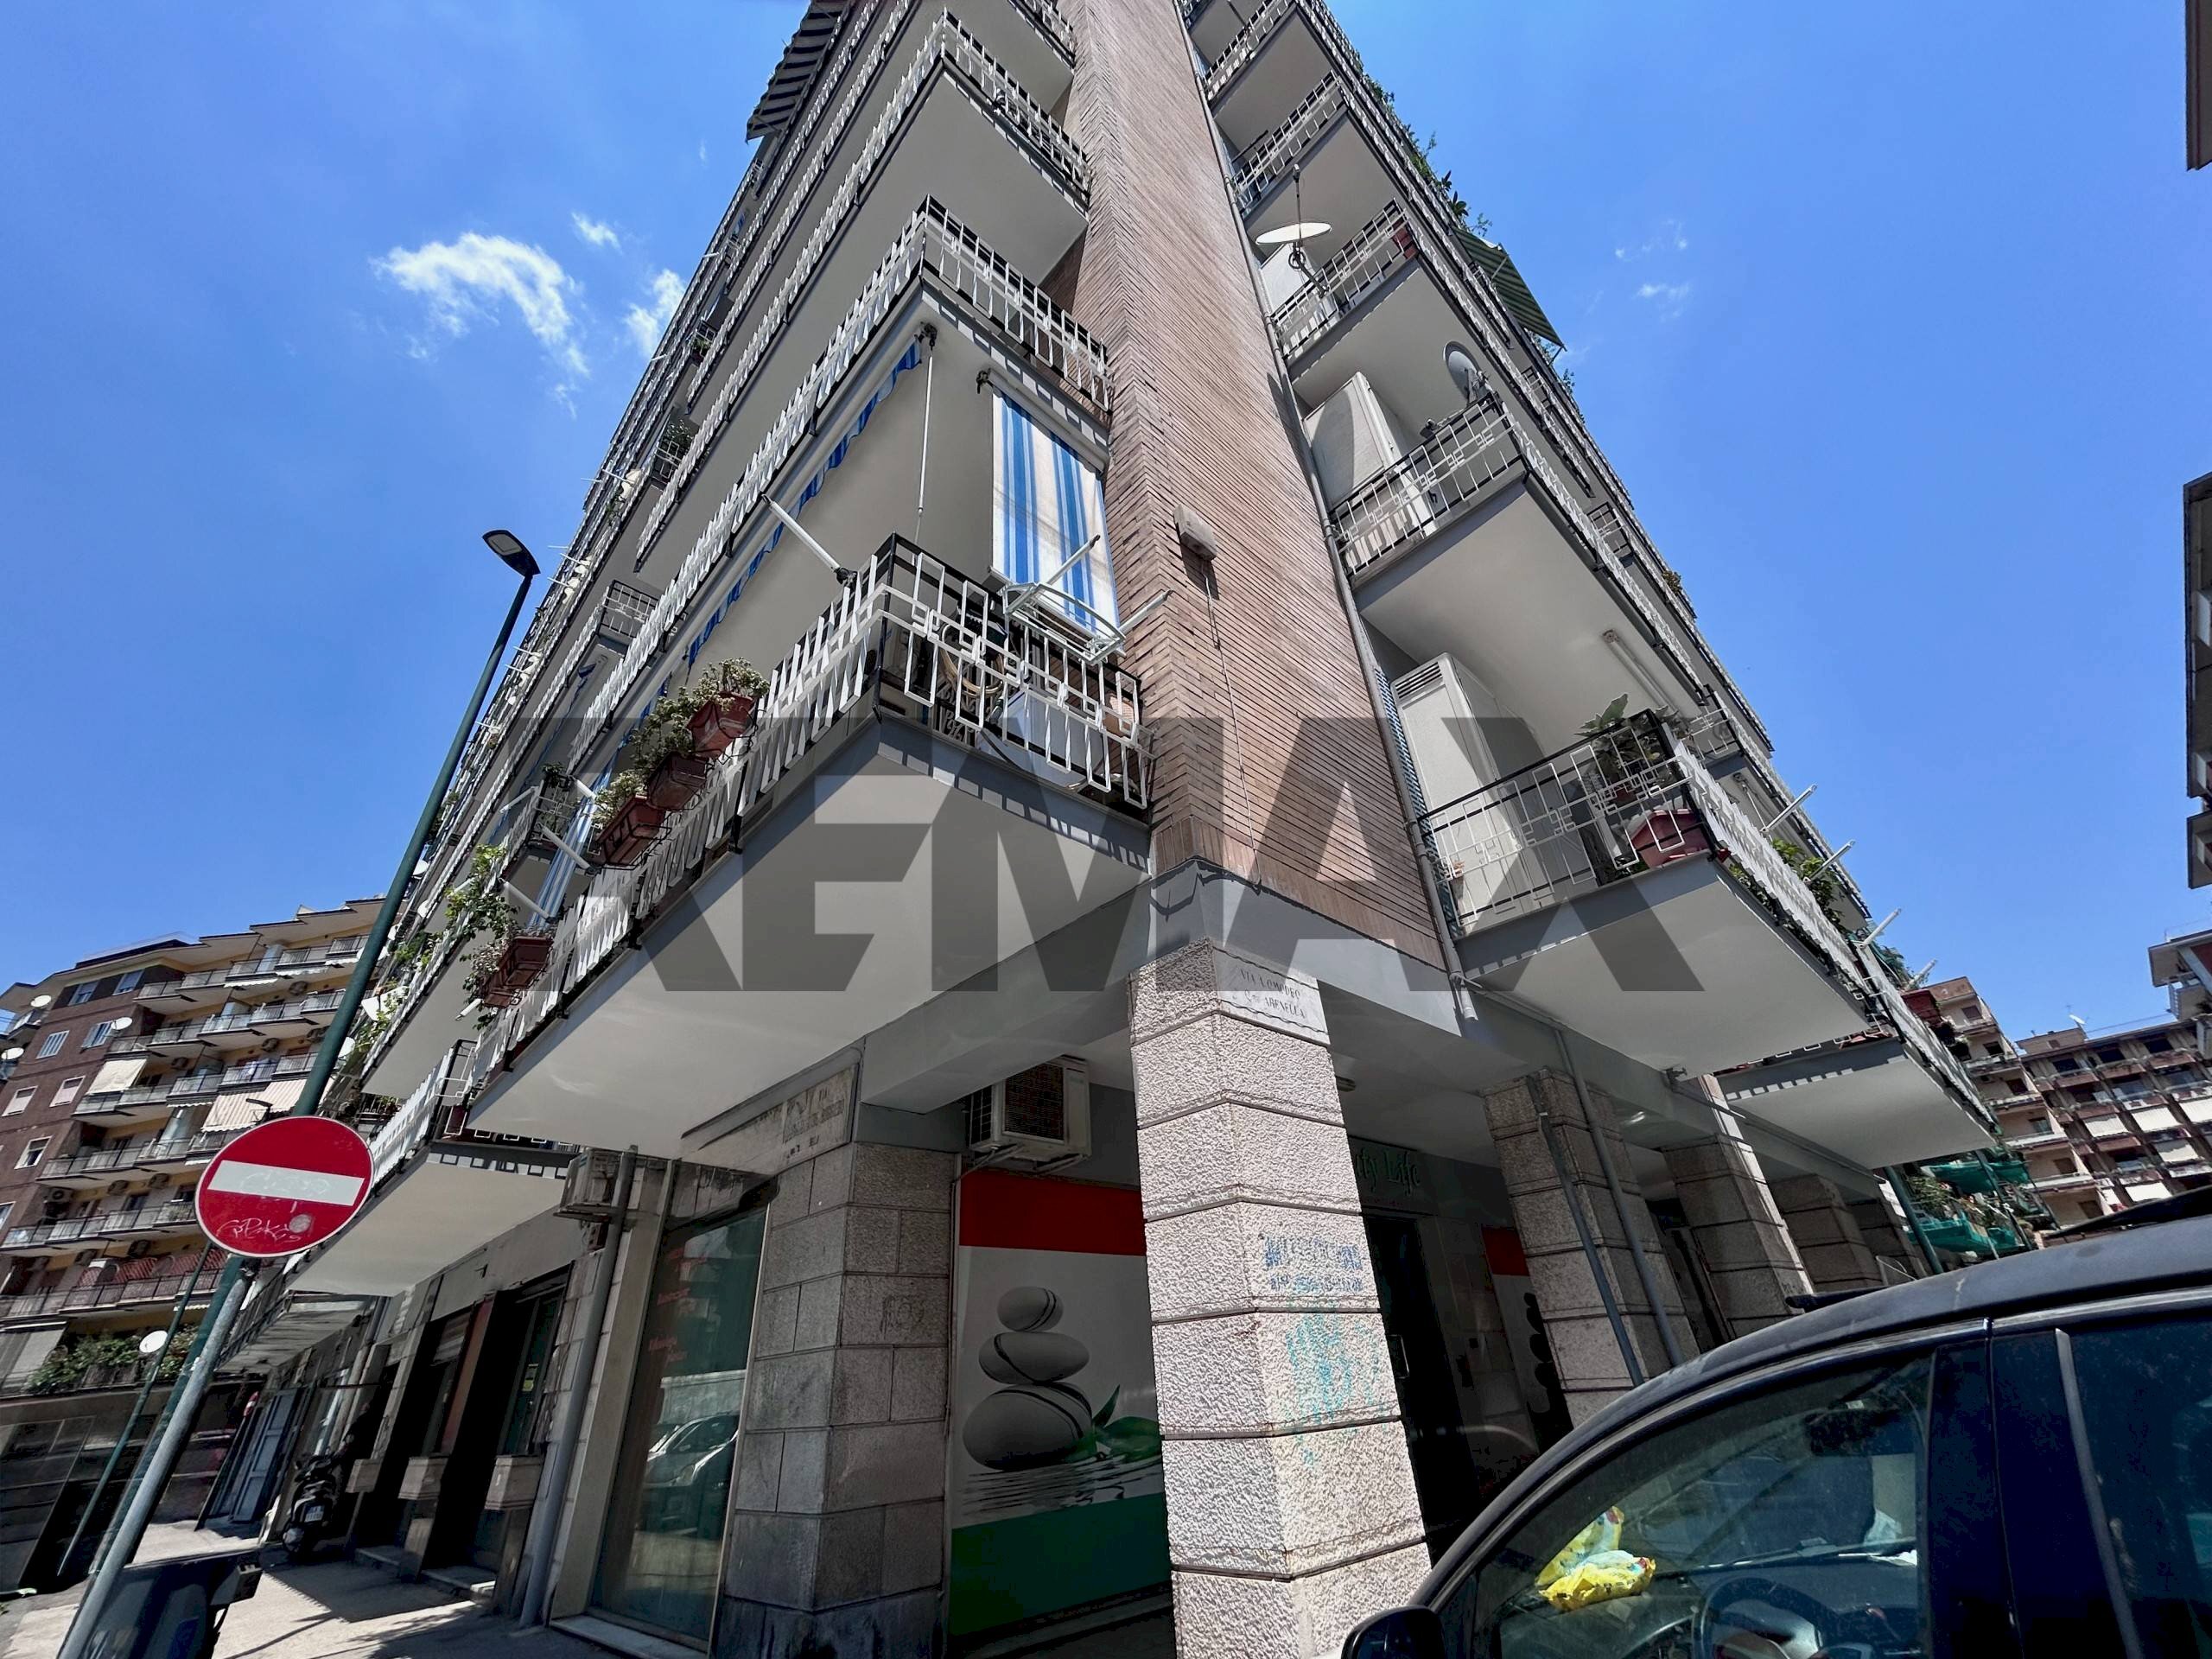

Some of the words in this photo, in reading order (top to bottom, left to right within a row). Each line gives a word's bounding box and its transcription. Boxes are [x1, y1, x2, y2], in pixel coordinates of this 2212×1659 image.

[1240, 968, 1256, 984] VIA
[1265, 996, 1306, 1020] ARENELLA
[1382, 1147, 1421, 1196] Life
